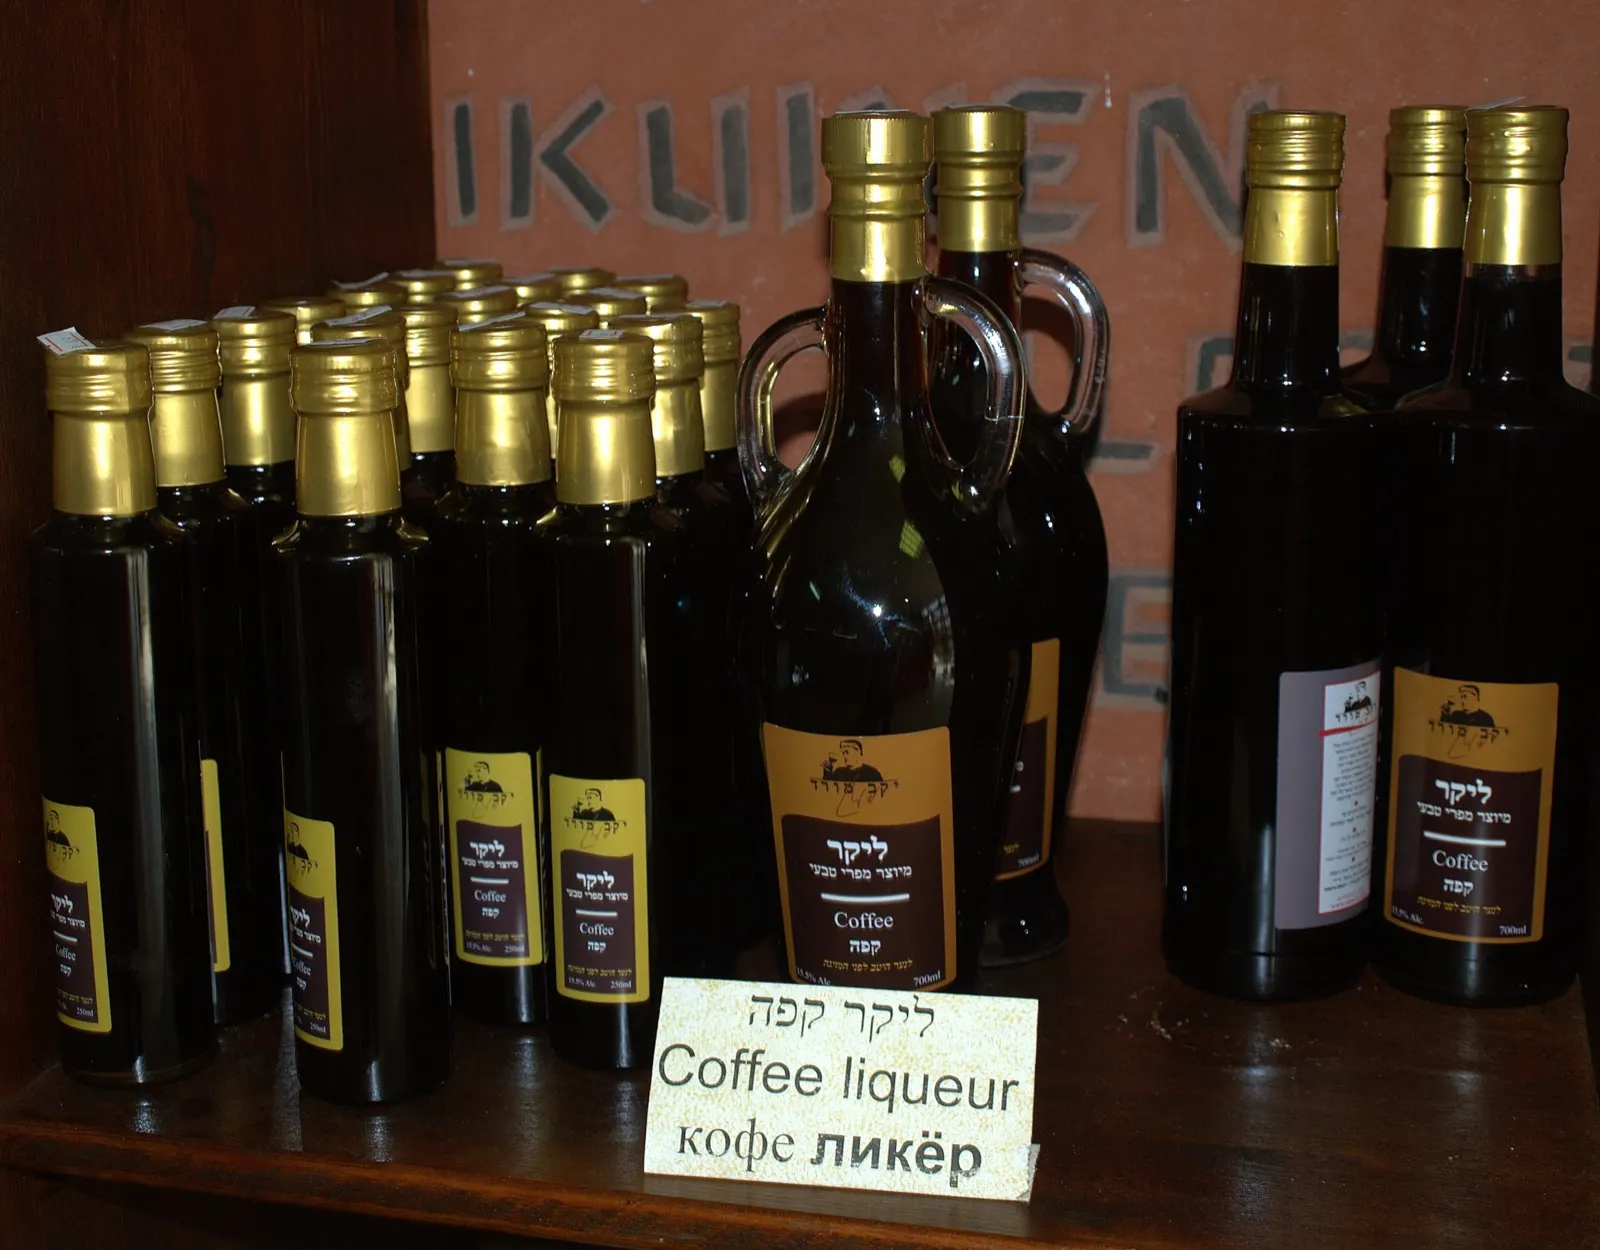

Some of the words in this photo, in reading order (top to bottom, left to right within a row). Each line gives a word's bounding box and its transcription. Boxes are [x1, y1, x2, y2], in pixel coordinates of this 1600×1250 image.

[1434, 777, 1493, 805] ליקר
[1417, 801, 1442, 818] טבעי
[1445, 808, 1473, 822] מפרי
[1476, 811, 1511, 824] מיוצר
[470, 840, 505, 859] ליקר
[826, 834, 888, 865] ליקר
[1432, 850, 1488, 872] Coffee
[809, 862, 837, 879] טבעי
[841, 865, 872, 880] מפרי
[876, 865, 913, 879] מיוצר
[576, 870, 614, 891] ליקר
[1443, 878, 1474, 897] קפה
[474, 889, 506, 903] Coffee
[584, 890, 603, 901] מפרי
[605, 890, 628, 901] מיוצר
[482, 907, 499, 920] קפה
[833, 911, 894, 929] Coffee
[579, 922, 614, 937] Coffee
[1499, 924, 1527, 935] 700ml
[55, 943, 76, 962] Coffee
[587, 940, 606, 954] קפה
[849, 938, 881, 956] קפה
[610, 979, 632, 989] 250ml
[913, 970, 941, 987] 700ml
[76, 1006, 94, 1018] 250ml
[749, 994, 825, 1038] קפה
[844, 994, 935, 1042] ליקר
[658, 1042, 823, 1096] Coffee
[842, 1055, 1020, 1114] liqueur
[678, 1117, 795, 1173] кофе
[809, 1129, 983, 1188] ликёр
